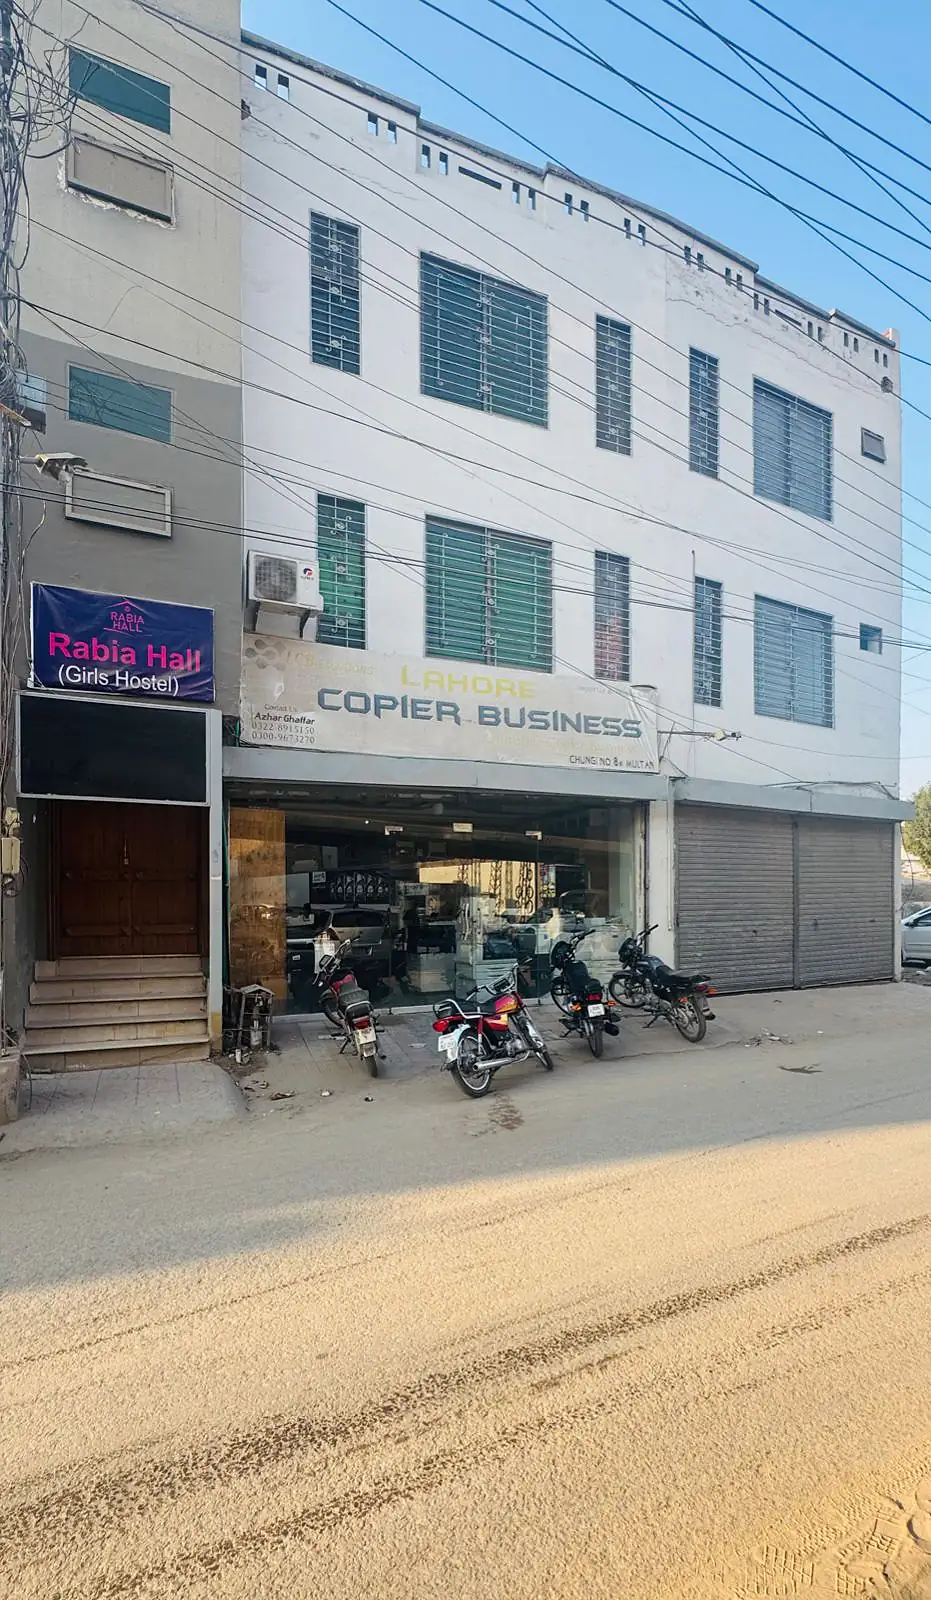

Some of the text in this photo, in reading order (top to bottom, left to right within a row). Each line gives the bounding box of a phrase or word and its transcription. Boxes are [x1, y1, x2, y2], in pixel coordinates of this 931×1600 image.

[110, 611, 145, 624] RABIA
[112, 621, 143, 633] HALL
[48, 631, 201, 673] Rabia Hall
[58, 663, 179, 697] (Girls Hostel)
[401, 664, 537, 698] LAHORE
[254, 711, 283, 722] Azhar
[317, 687, 643, 739] COPIER BUSINESS
